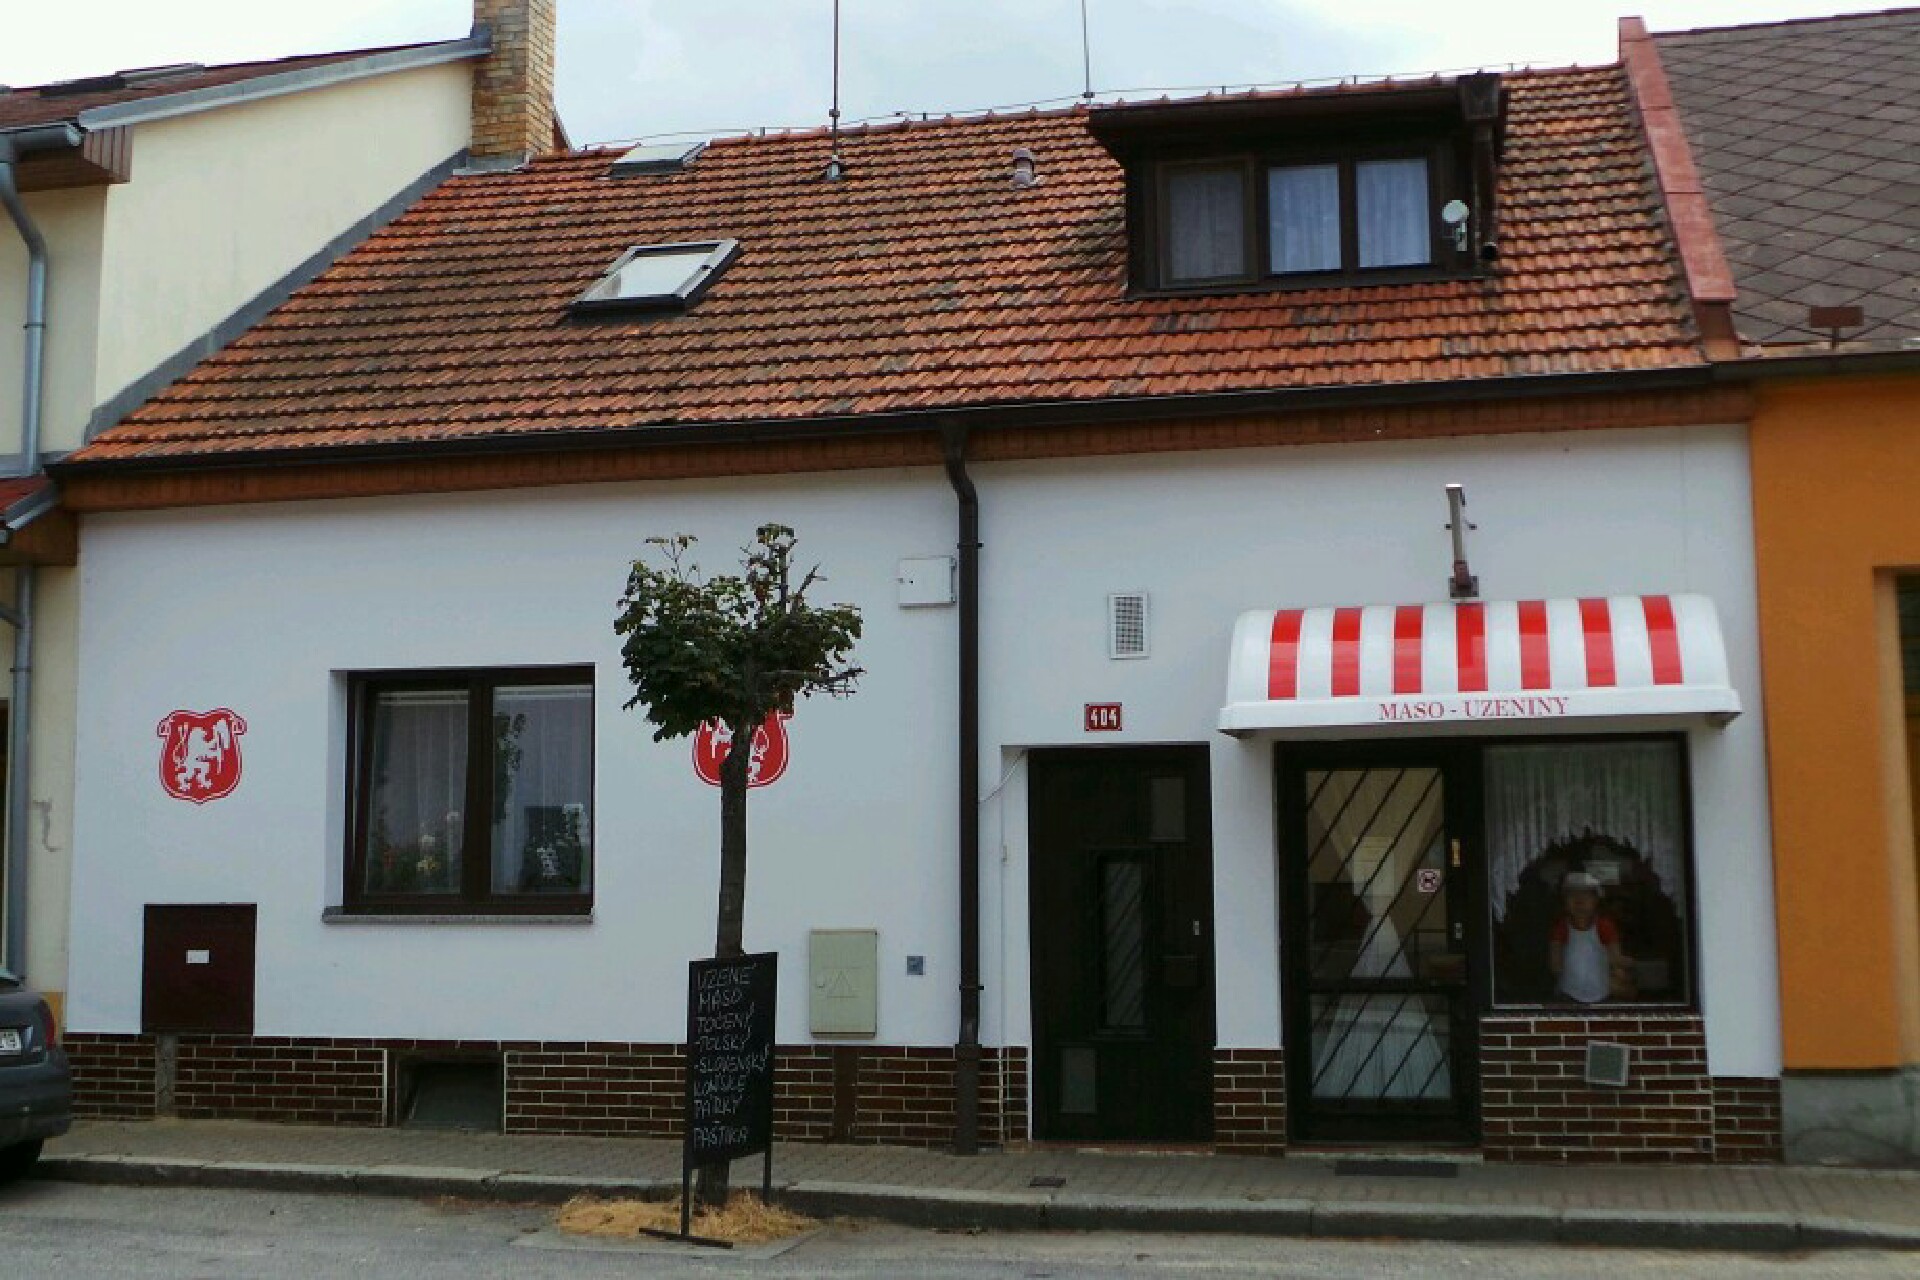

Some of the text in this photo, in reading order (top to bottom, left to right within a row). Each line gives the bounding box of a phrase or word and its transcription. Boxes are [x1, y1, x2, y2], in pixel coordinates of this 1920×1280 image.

[1090, 707, 1117, 728] 404
[1379, 701, 1445, 720] MASO
[1464, 697, 1570, 718] UZENINY
[698, 988, 742, 1013] MASO
